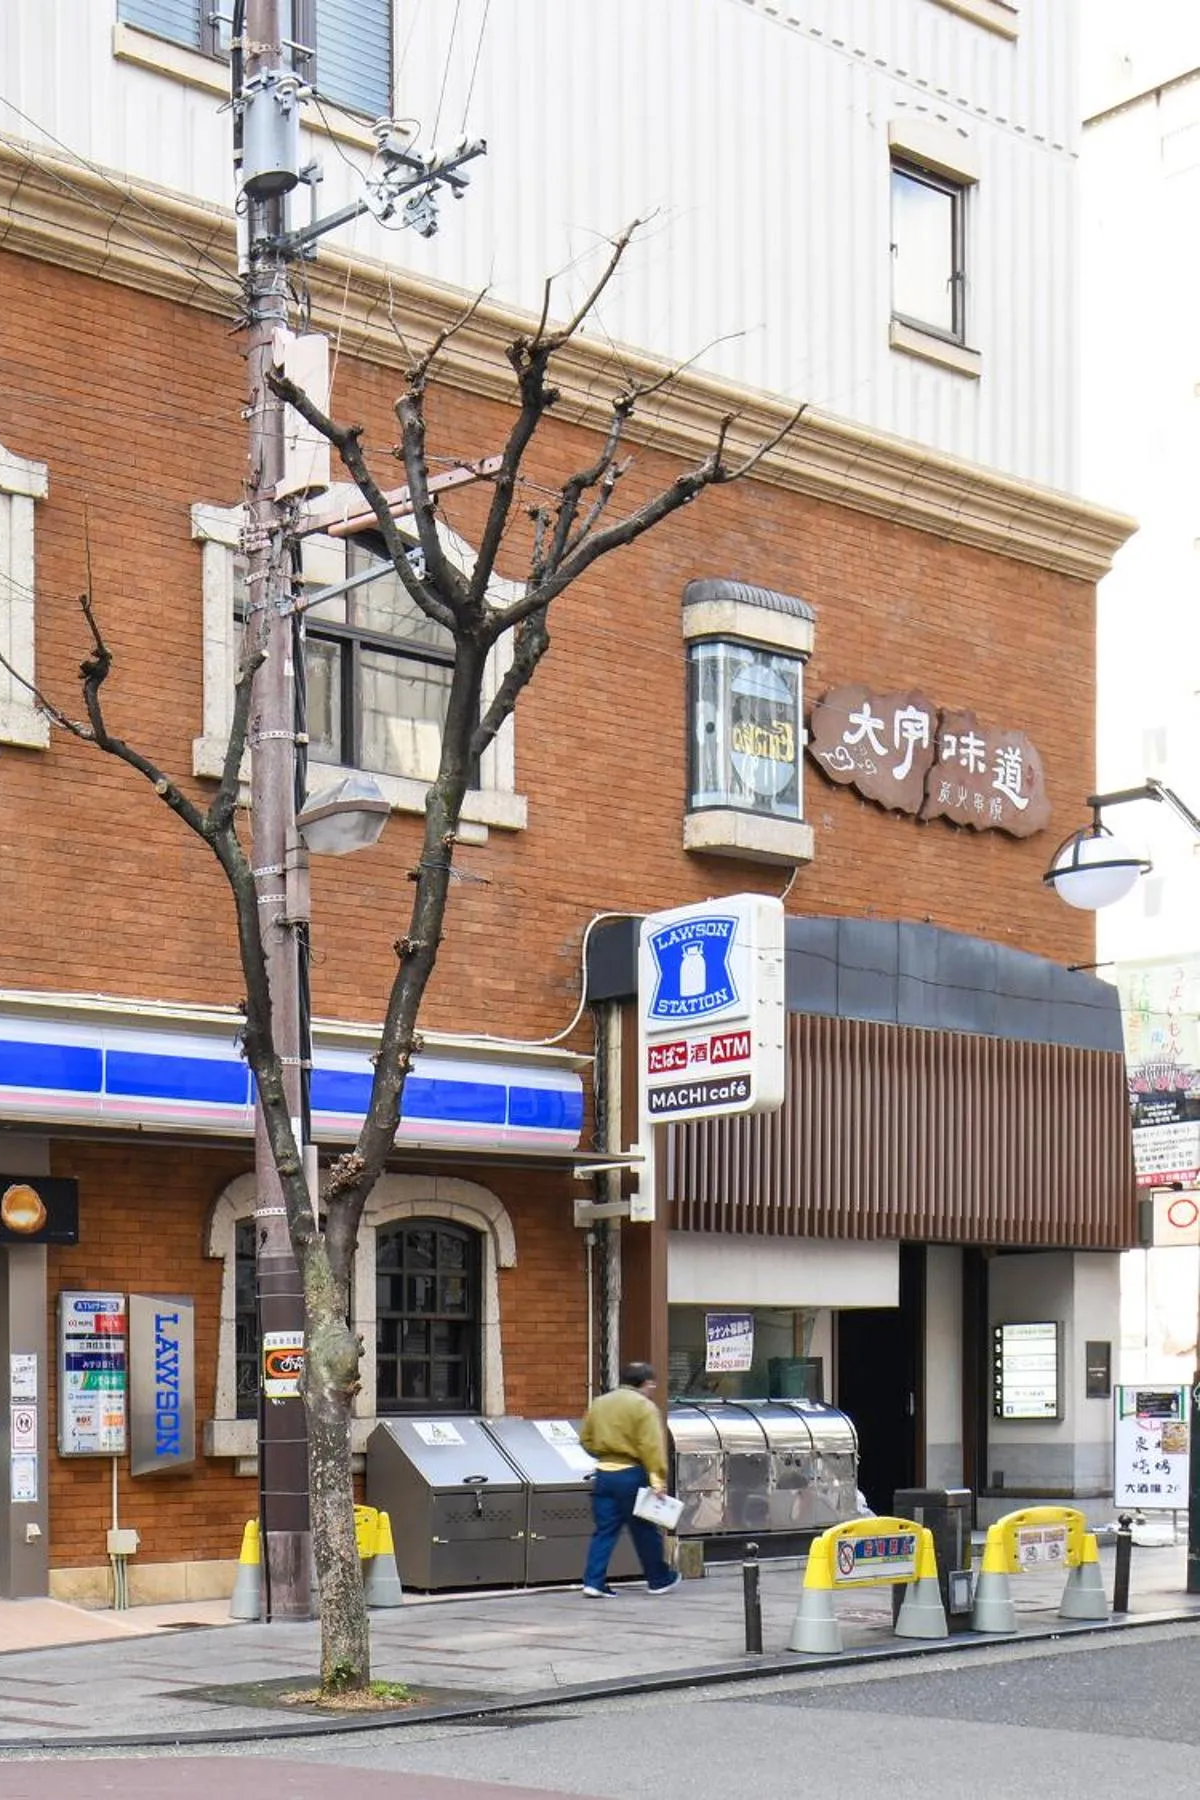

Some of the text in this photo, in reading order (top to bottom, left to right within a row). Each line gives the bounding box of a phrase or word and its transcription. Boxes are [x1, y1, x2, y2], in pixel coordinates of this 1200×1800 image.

[657, 923, 729, 950] LAWSON
[657, 988, 729, 1014] STATION
[649, 1037, 749, 1070] たばこ 酒 ATM
[652, 1080, 747, 1109] MACHI café
[154, 1313, 180, 1457] LAWSON
